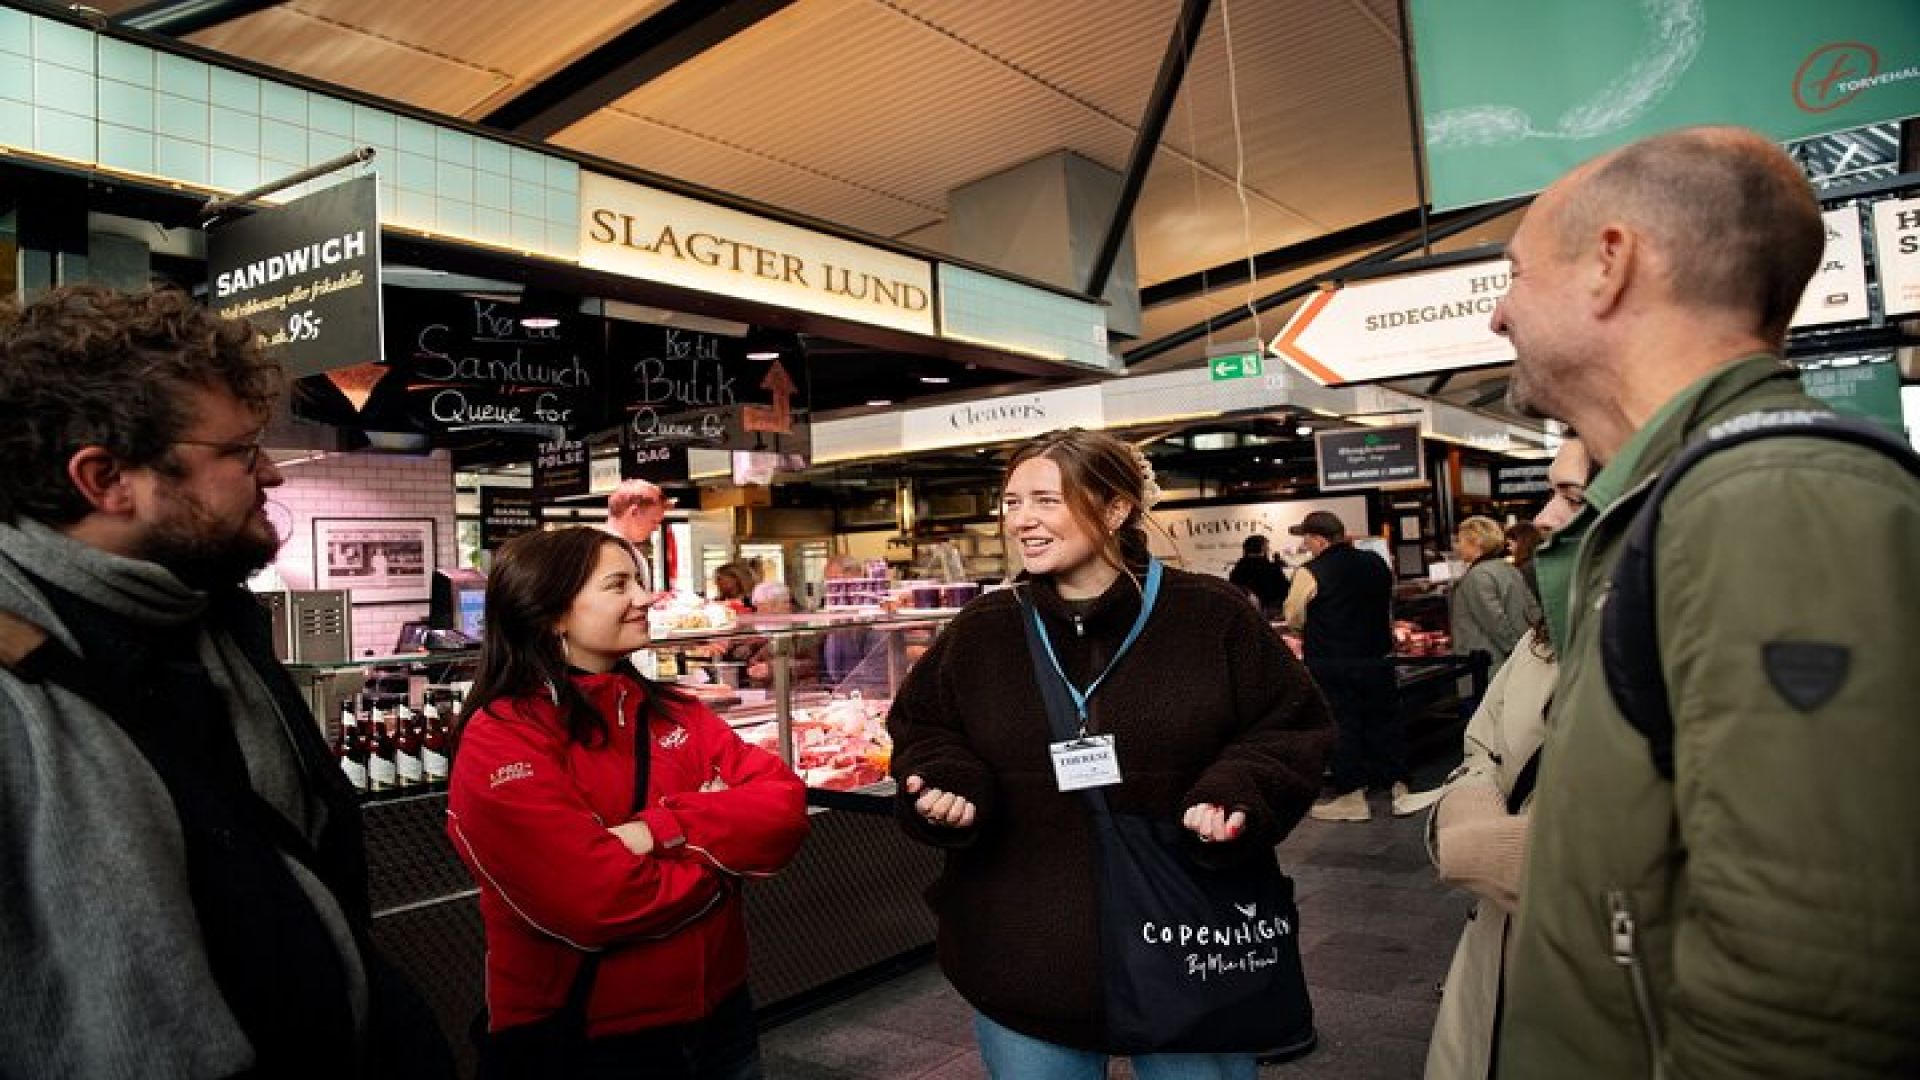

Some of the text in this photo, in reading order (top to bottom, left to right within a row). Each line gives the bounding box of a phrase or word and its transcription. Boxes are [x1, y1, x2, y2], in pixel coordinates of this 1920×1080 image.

[216, 231, 366, 298] SANDWICH
[589, 208, 929, 312] SLAGTER LUND
[473, 299, 515, 337] Kø
[1364, 296, 1502, 332] SIDEGANG
[416, 323, 591, 387] Sandwich
[666, 327, 691, 359] Kø
[633, 356, 737, 406] Butik
[431, 388, 573, 424] Queue for
[632, 406, 726, 438] Queue for
[946, 397, 1047, 429] Cleaver's
[1166, 513, 1274, 538] Cleaver's
